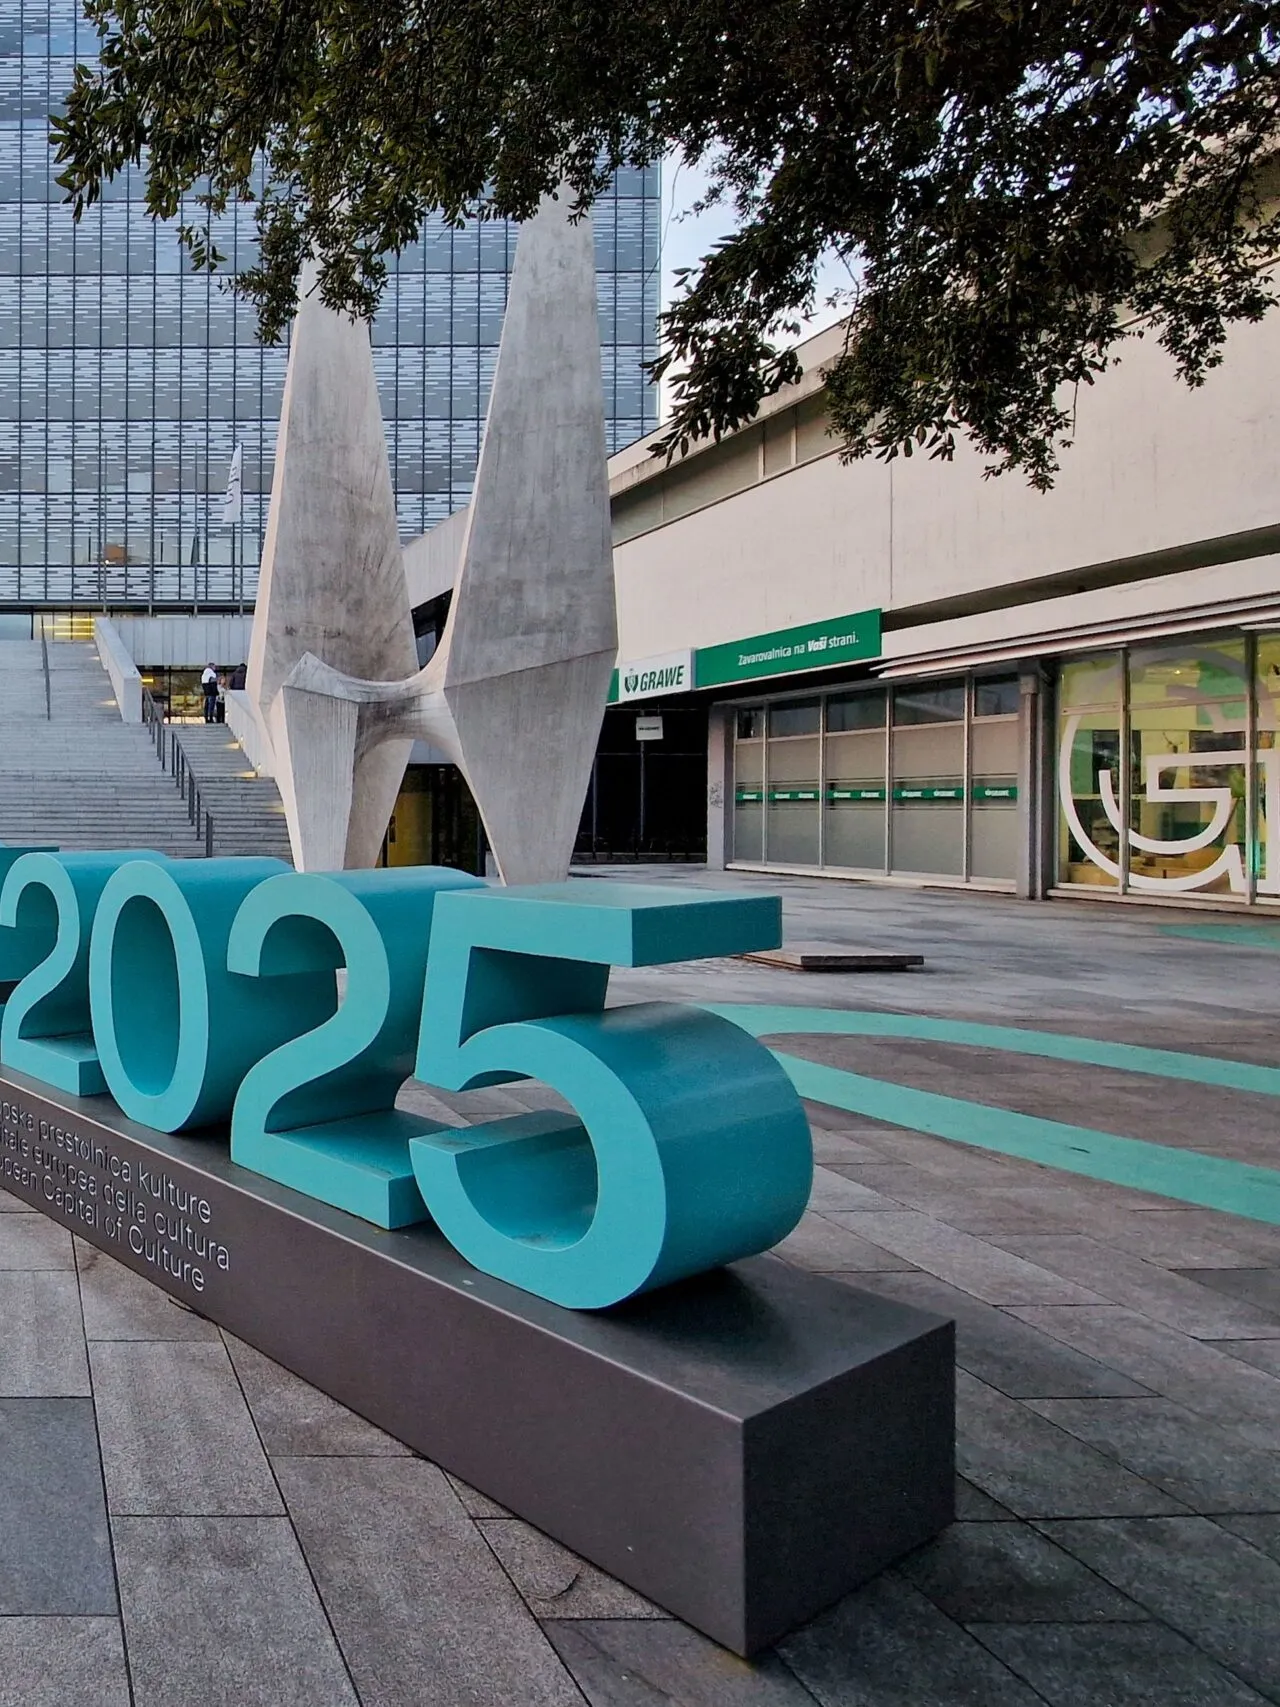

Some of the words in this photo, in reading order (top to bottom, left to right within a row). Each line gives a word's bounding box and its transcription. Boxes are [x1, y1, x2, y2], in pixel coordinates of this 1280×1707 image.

[640, 664, 685, 692] GRAWE
[737, 647, 792, 666] Zavarovalnica
[793, 644, 806, 655] na
[828, 631, 859, 648] strani.
[32, 1145, 97, 1196] europea
[103, 1179, 147, 1224] della
[154, 1211, 229, 1271] cultura
[39, 1119, 131, 1183] prestolnica
[137, 1161, 211, 1223] kulture
[42, 1174, 99, 1229] Capital
[104, 1216, 122, 1242] of
[128, 1224, 205, 1292] Culture
